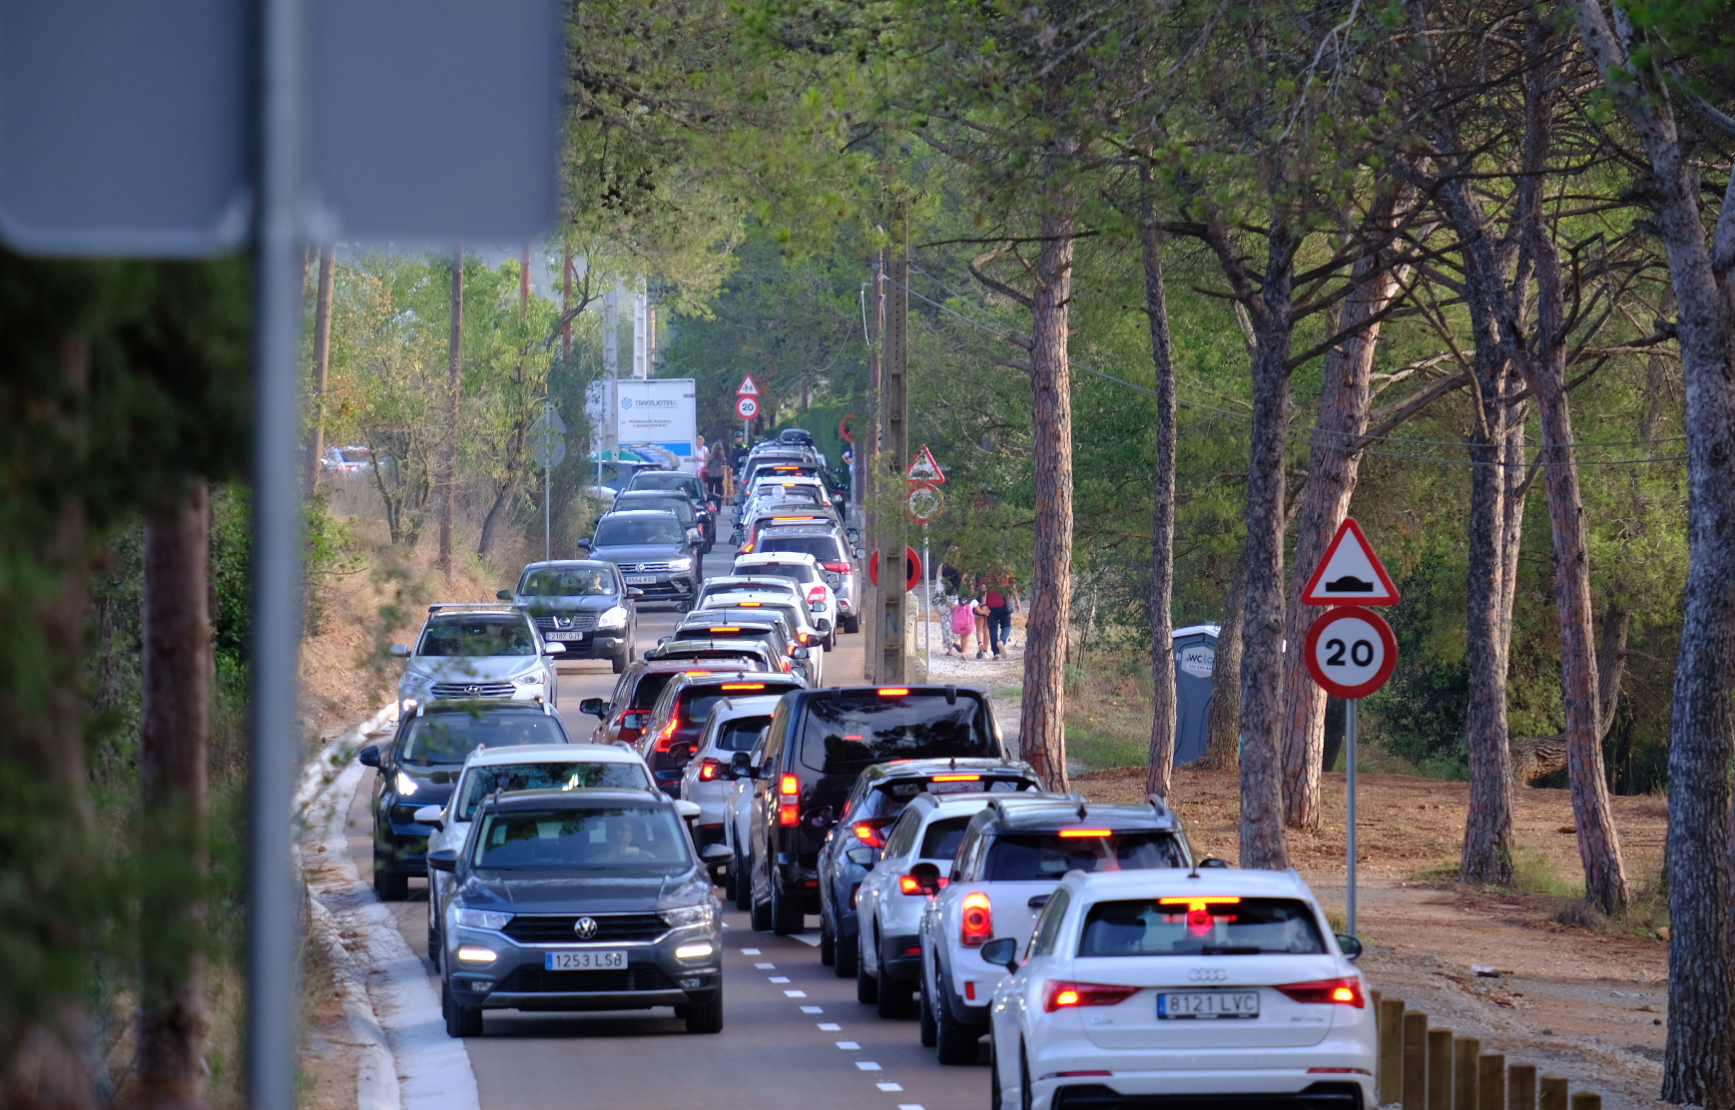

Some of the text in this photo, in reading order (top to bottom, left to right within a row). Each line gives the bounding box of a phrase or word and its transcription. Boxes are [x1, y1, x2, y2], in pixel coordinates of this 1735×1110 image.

[741, 403, 754, 411] 20
[1325, 638, 1374, 667] 20
[556, 953, 622, 967] 1253 LSB
[1170, 995, 1254, 1012] 8121 LVC
